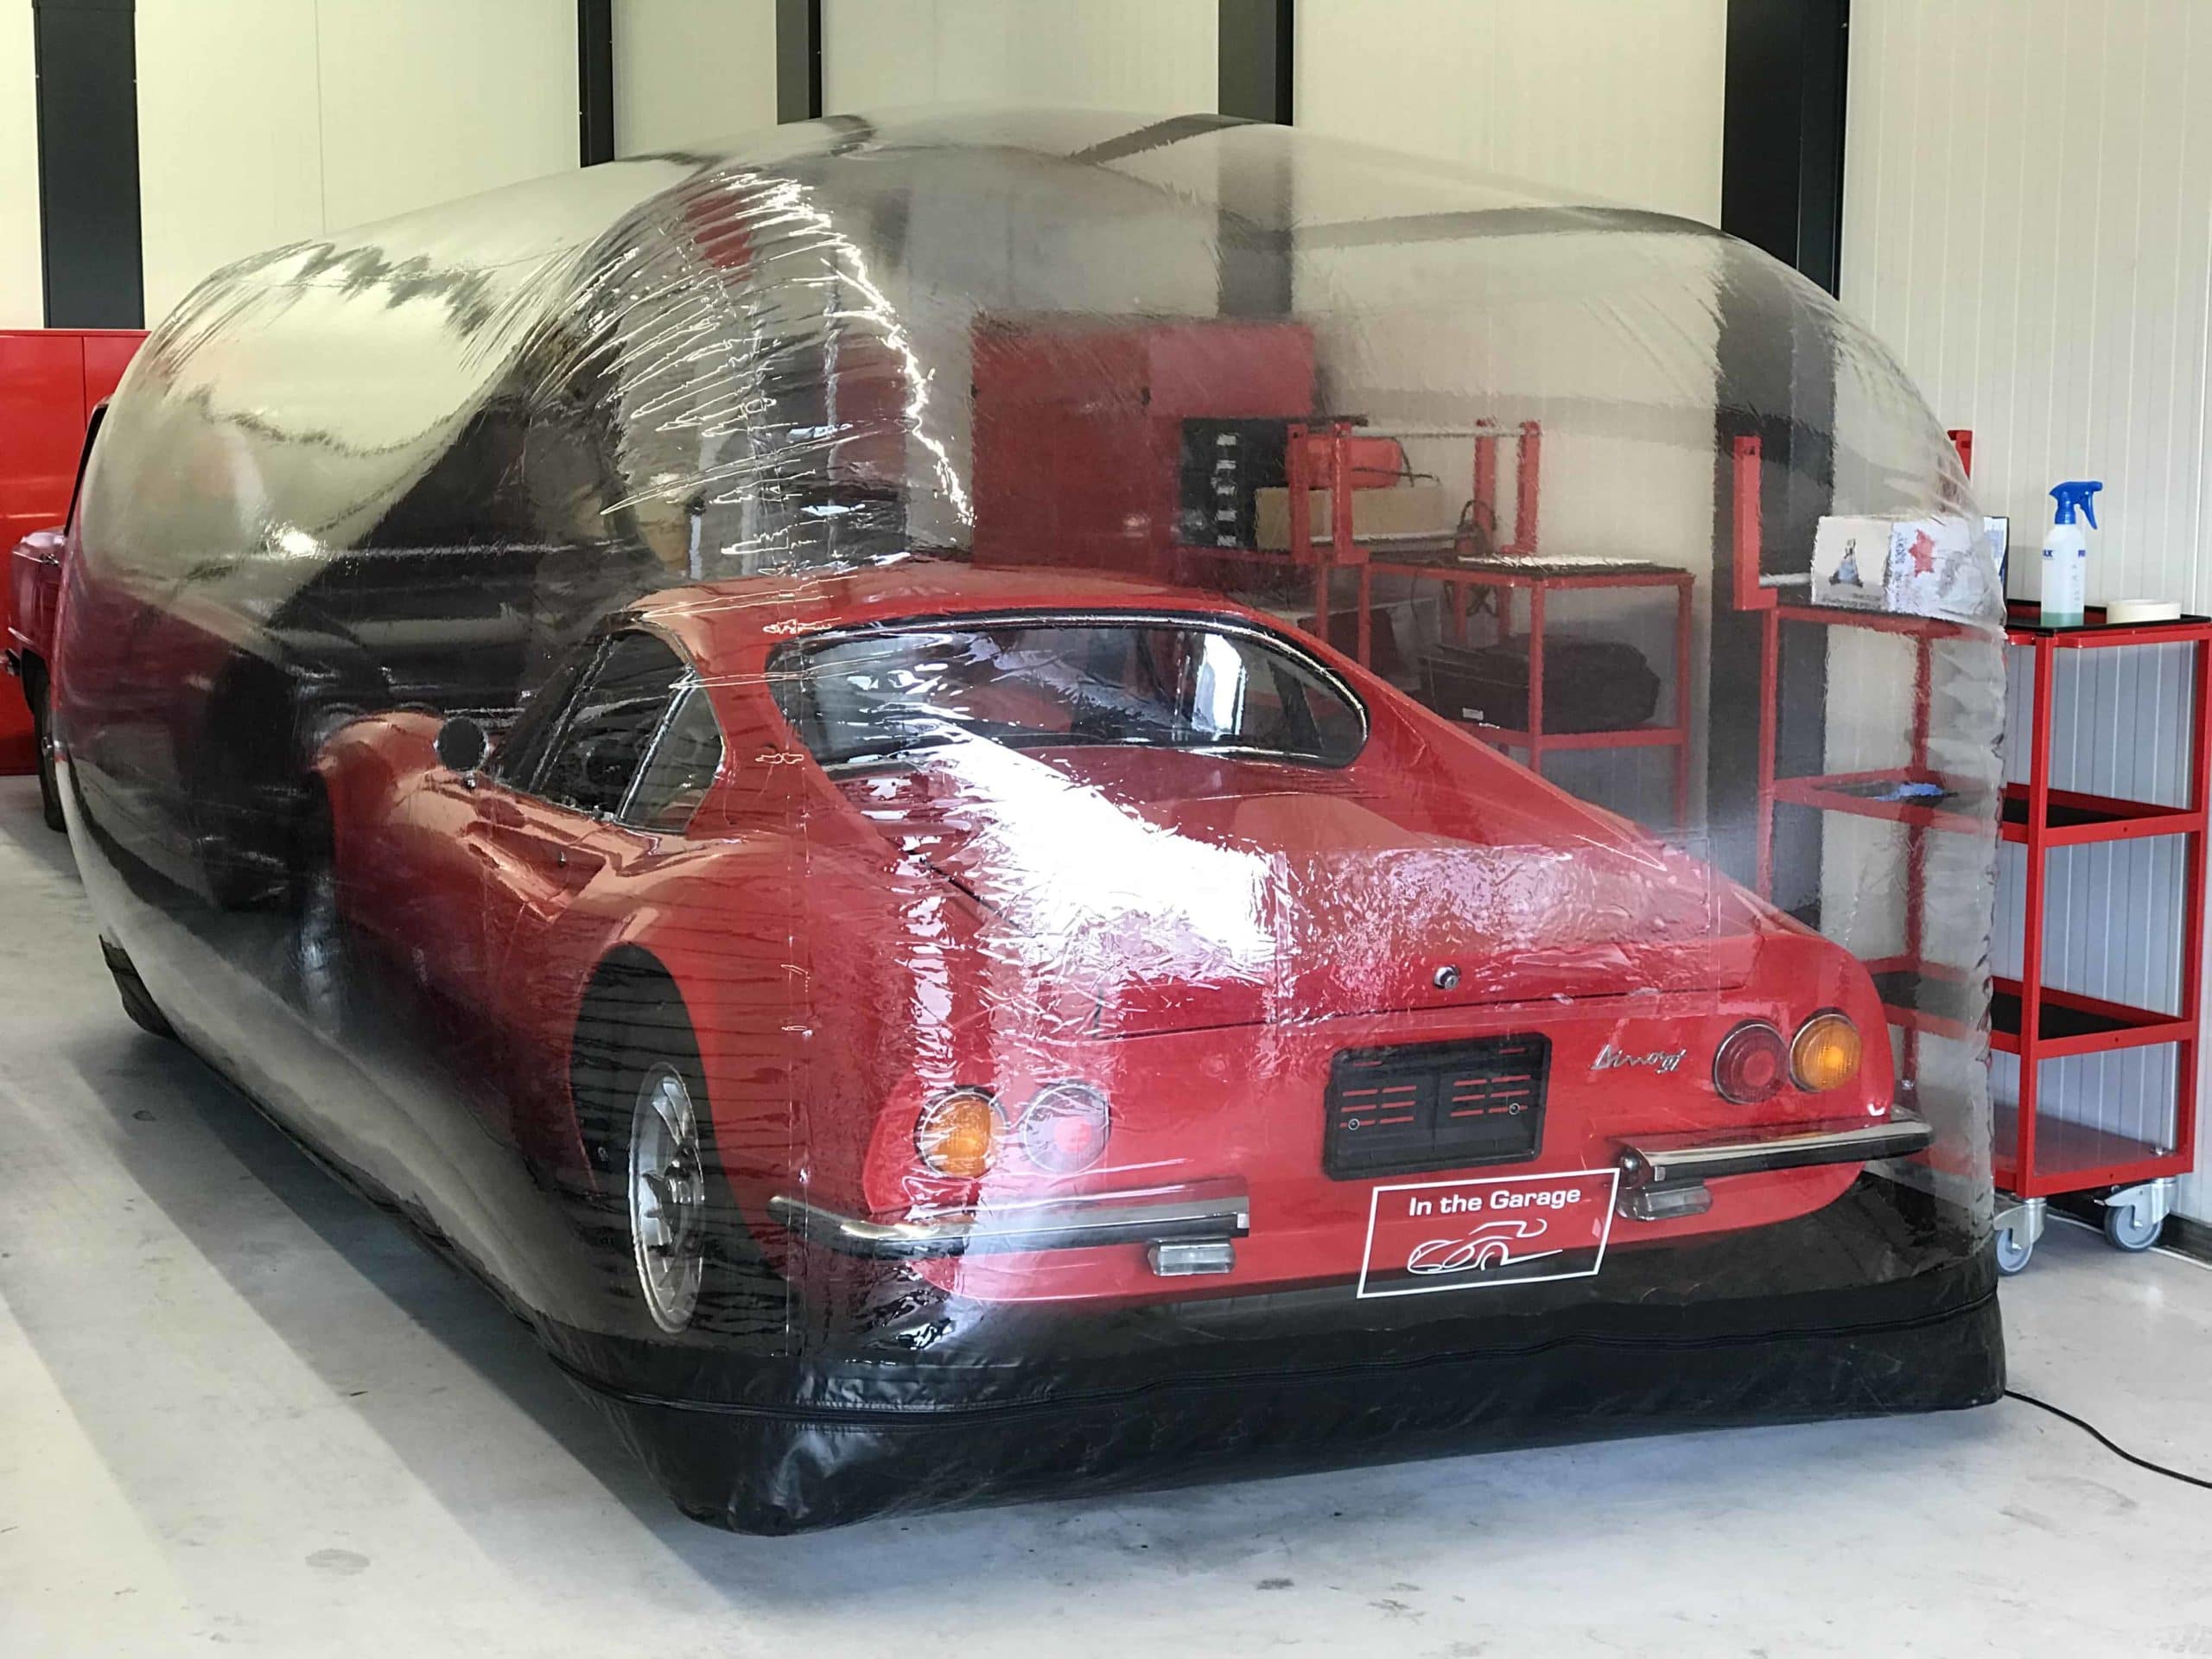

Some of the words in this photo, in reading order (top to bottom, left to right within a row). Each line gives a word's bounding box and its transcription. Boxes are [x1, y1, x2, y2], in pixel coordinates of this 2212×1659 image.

[1409, 1197, 1432, 1216] In
[1440, 1194, 1483, 1213] the
[1490, 1189, 1581, 1209] Garage
